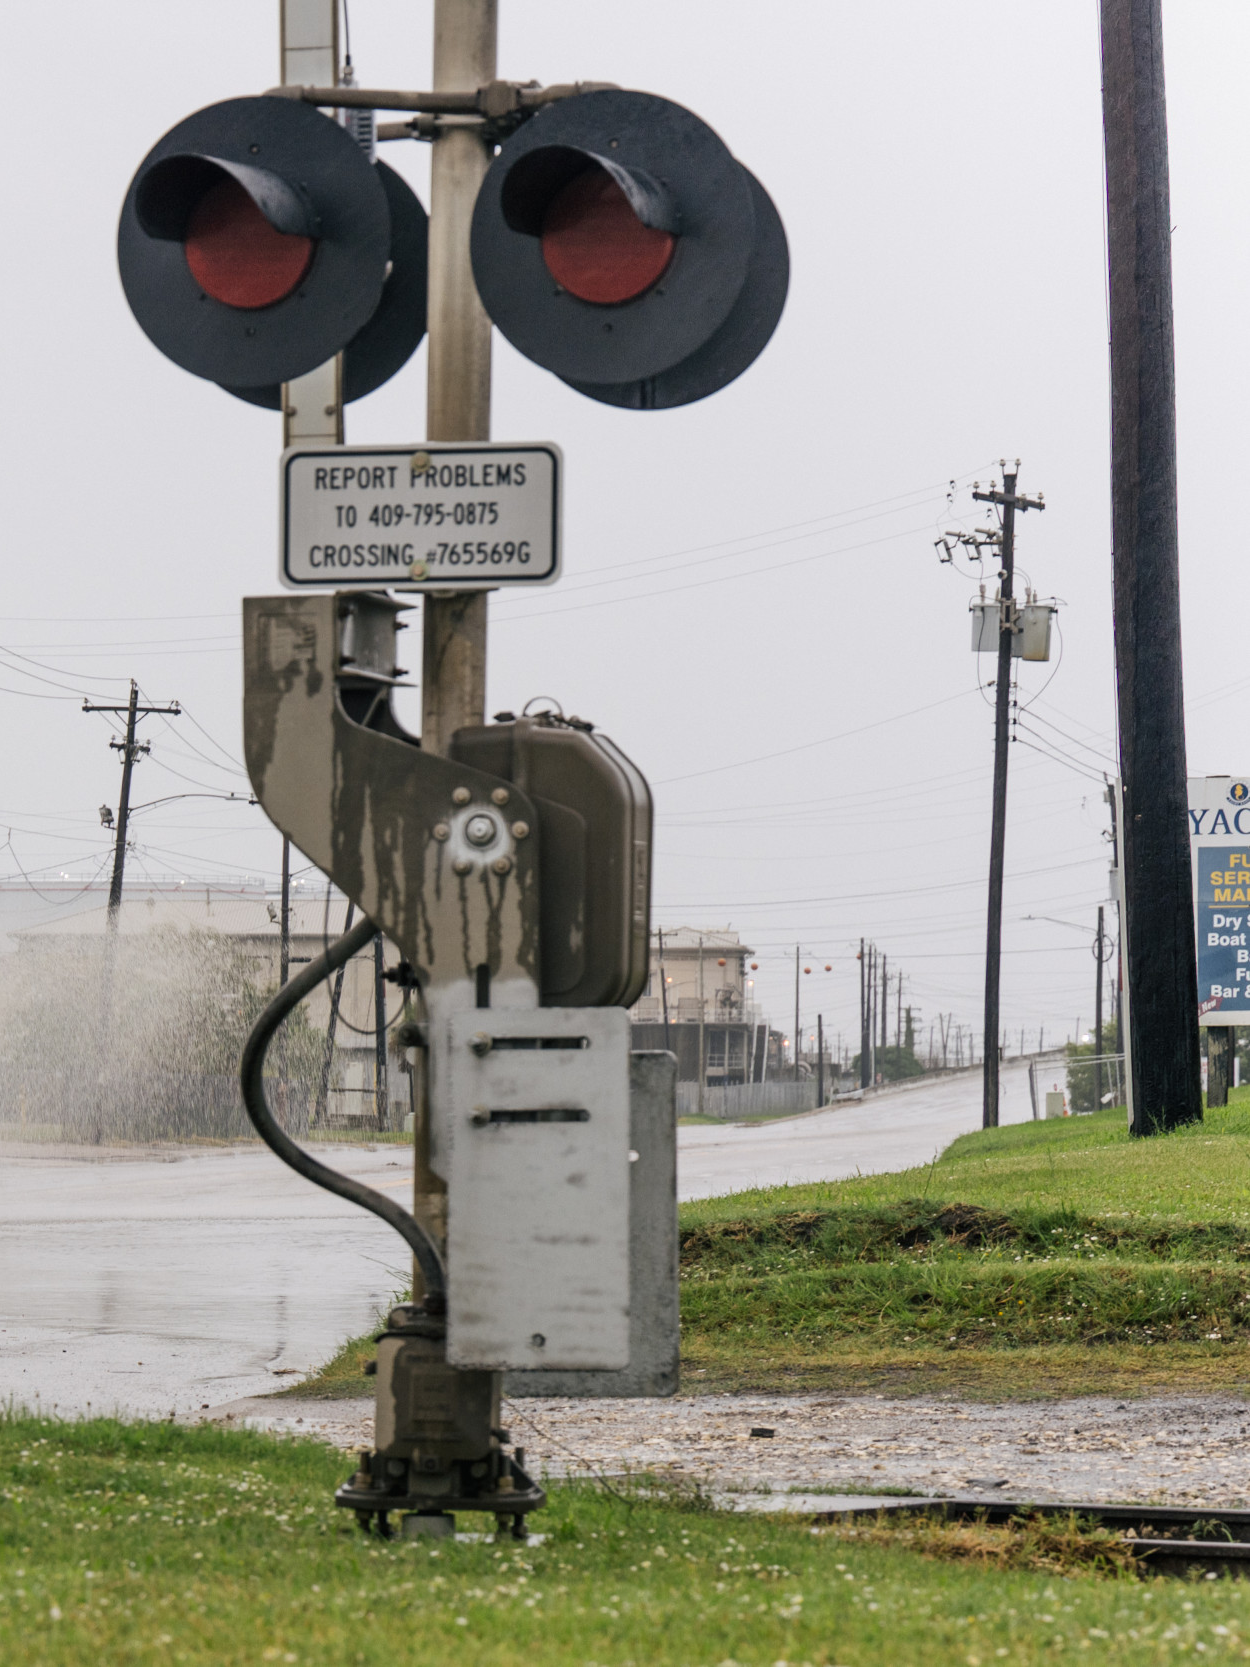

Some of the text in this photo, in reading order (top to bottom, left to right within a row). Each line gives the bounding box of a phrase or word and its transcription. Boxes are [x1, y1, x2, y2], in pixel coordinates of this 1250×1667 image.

[315, 463, 526, 490] REPORT PROBLEMS
[335, 502, 499, 528] TO 409-795-0875
[309, 541, 531, 568] CROSSING #765569G
[1189, 808, 1250, 836] YAC
[1210, 870, 1250, 886] SER
[1214, 888, 1250, 902] MA
[1212, 914, 1243, 931] Dry
[1207, 933, 1246, 947] Boat
[1237, 950, 1250, 963] B
[1210, 984, 1240, 998] Bar
[1202, 998, 1217, 1012] New
